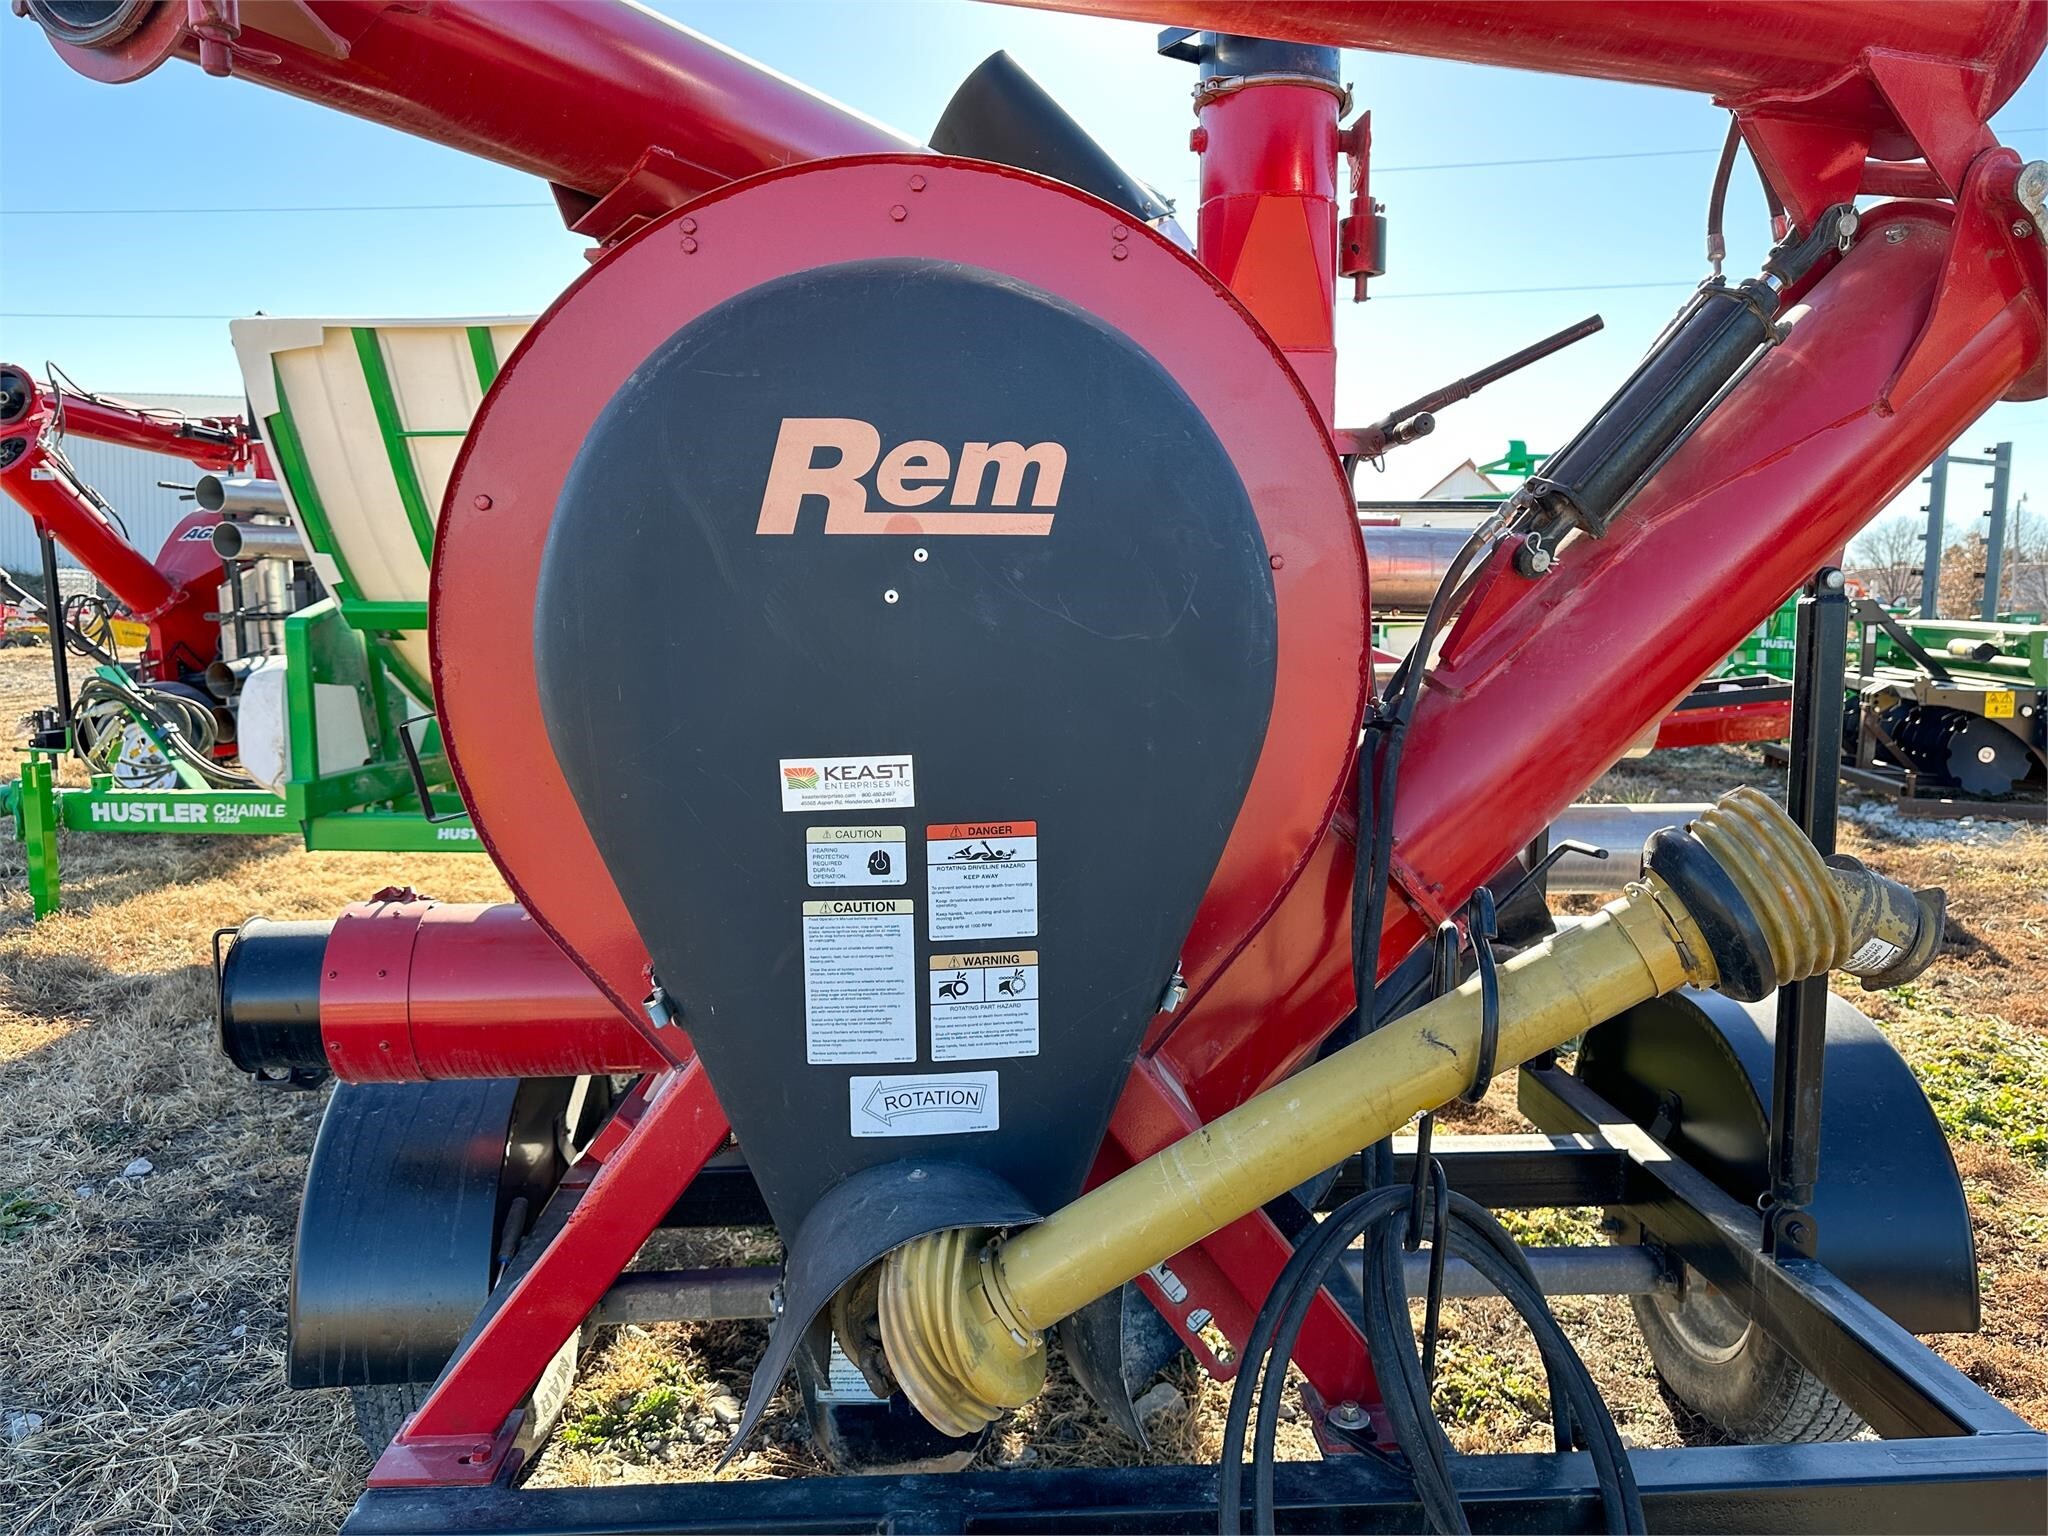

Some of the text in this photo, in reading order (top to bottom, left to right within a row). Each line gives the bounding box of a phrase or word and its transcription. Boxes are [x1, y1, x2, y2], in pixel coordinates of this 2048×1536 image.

[755, 417, 1068, 535] Rem
[183, 528, 213, 539] AG
[824, 763, 909, 781] KEAST
[824, 779, 911, 790] ENTERPRISES INC
[90, 802, 287, 823] HUSTLER CHAINLE
[835, 829, 882, 839] CAUTION
[968, 825, 1013, 836] DANGER
[833, 901, 896, 913] CAUTION
[963, 954, 1020, 966] WARNING
[949, 1004, 980, 1012] ROTATING
[884, 1090, 979, 1111] ROTATION
